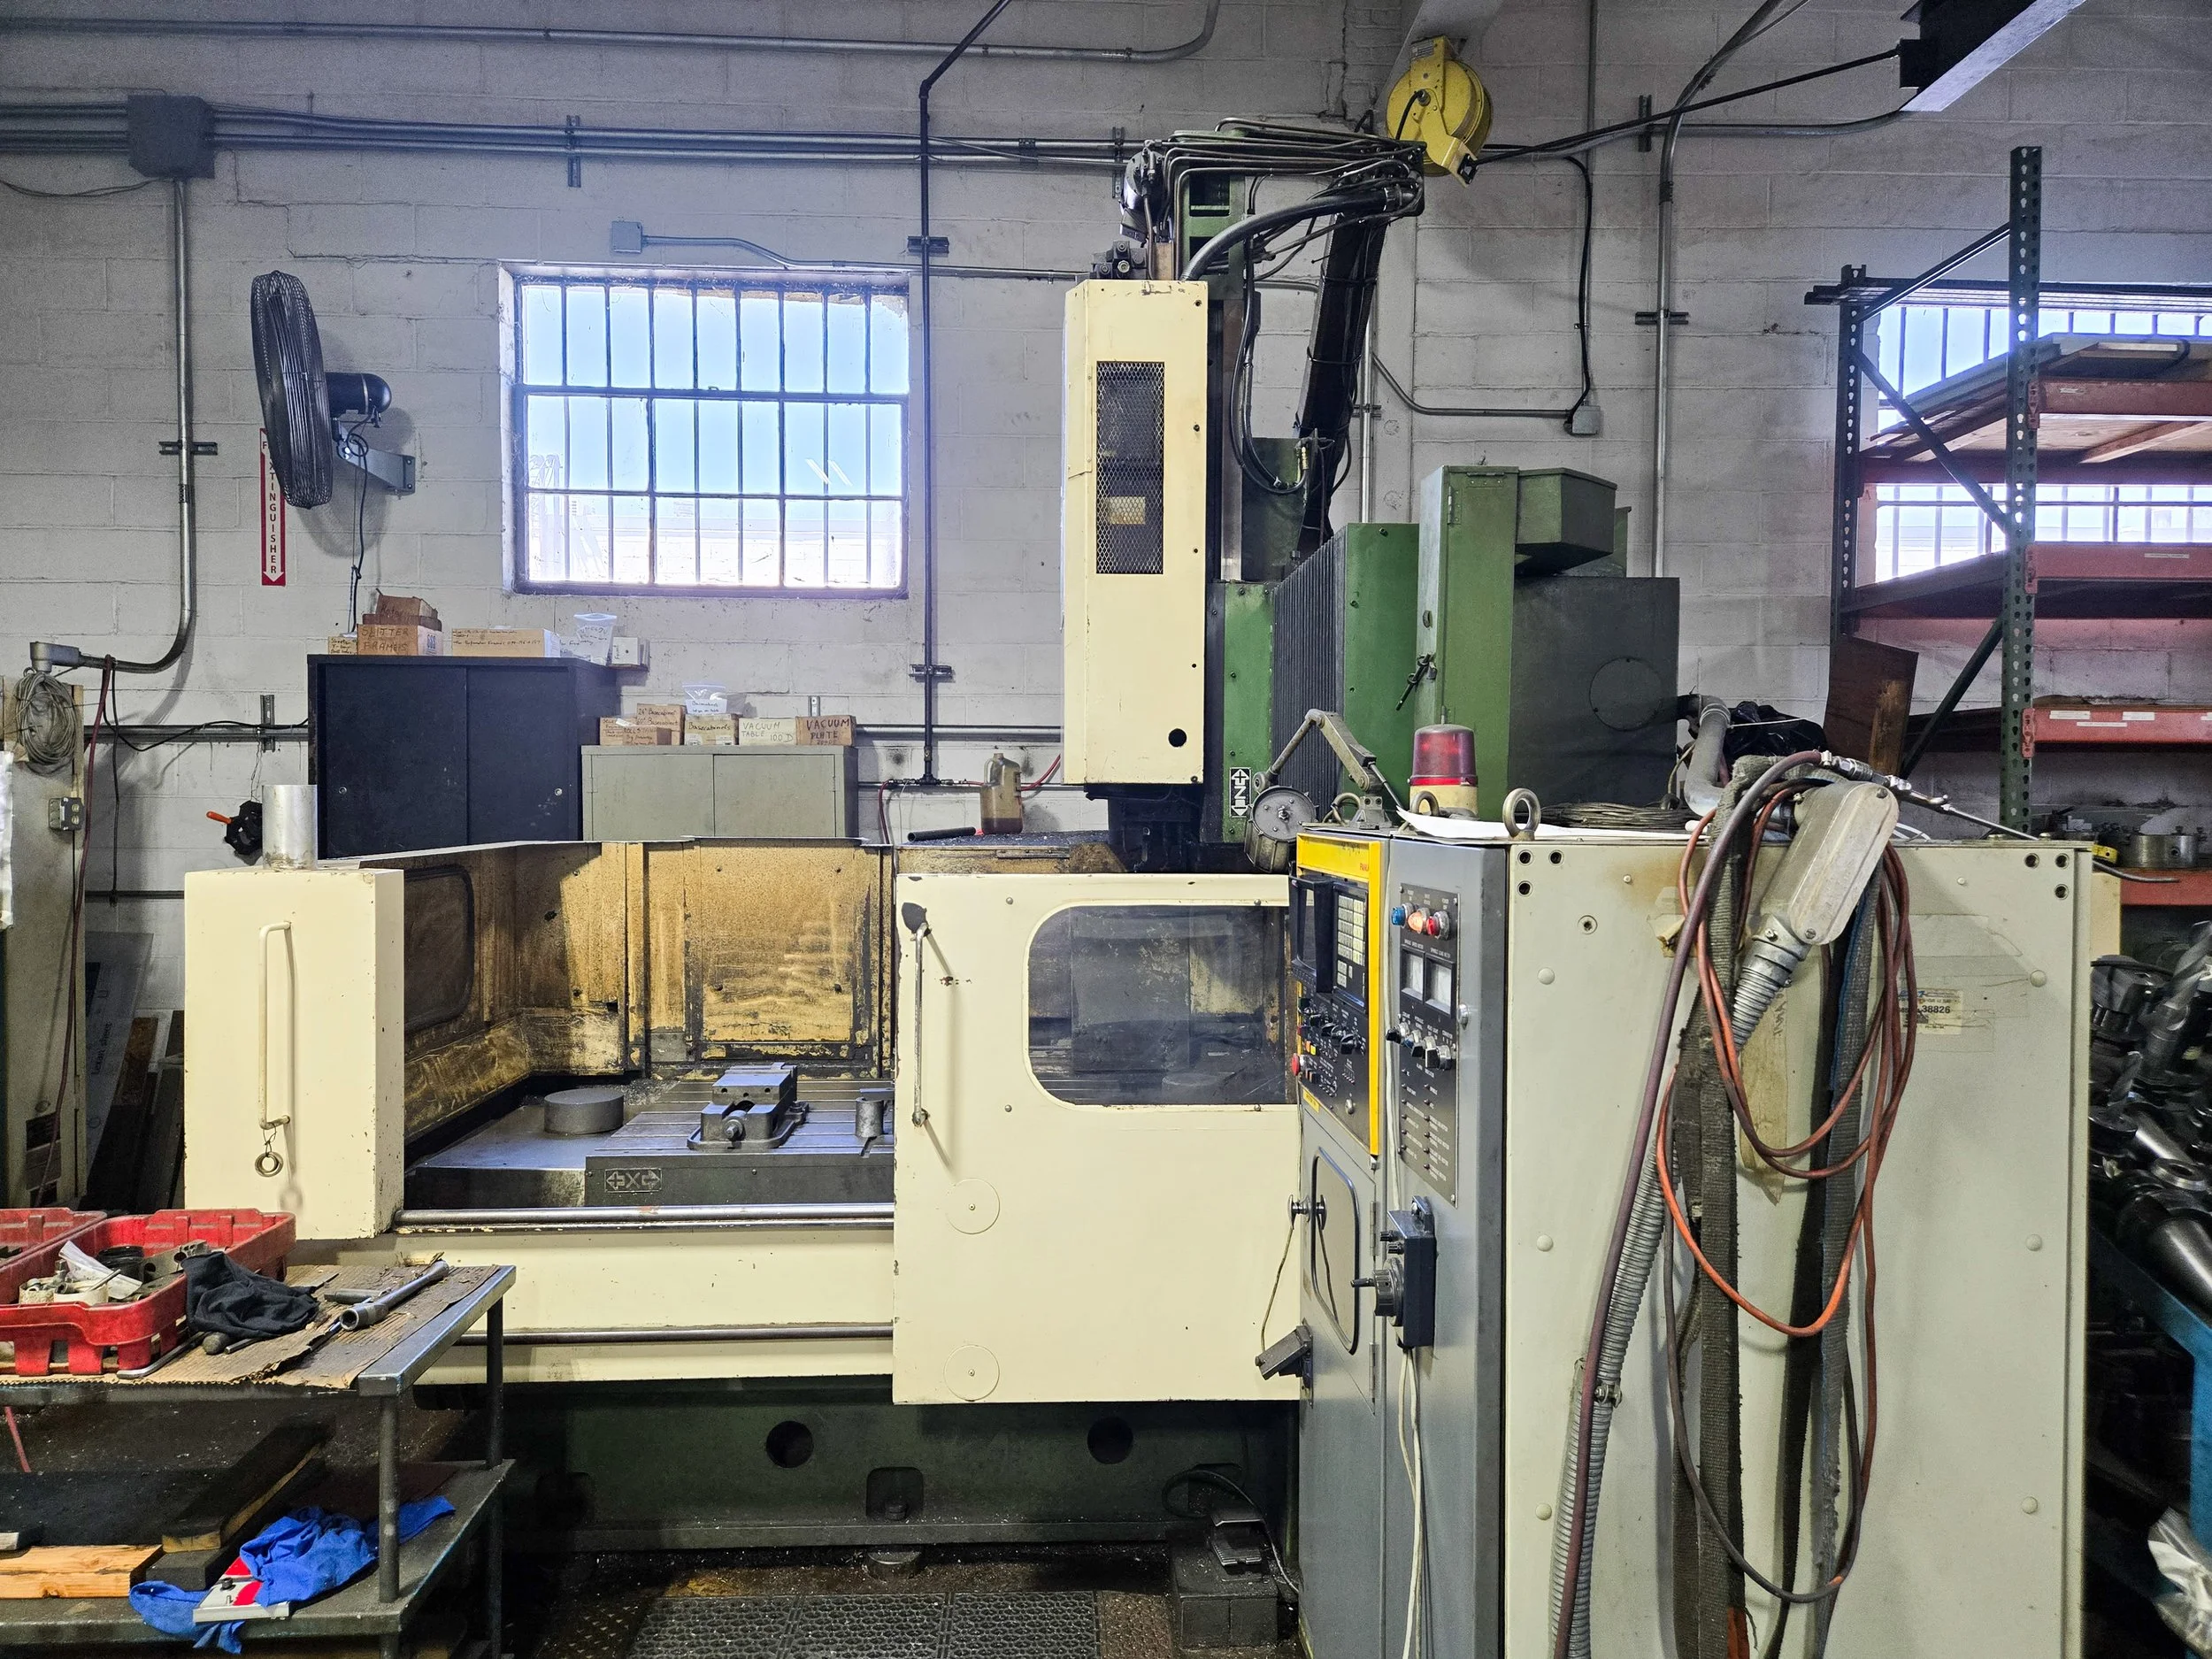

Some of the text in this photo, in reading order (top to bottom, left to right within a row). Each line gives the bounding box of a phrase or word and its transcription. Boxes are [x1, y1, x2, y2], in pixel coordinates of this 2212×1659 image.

[361, 626, 410, 637] SLITTER
[742, 721, 780, 731] VACUUM
[806, 718, 849, 730] VACUUM
[810, 730, 839, 741] PLATE
